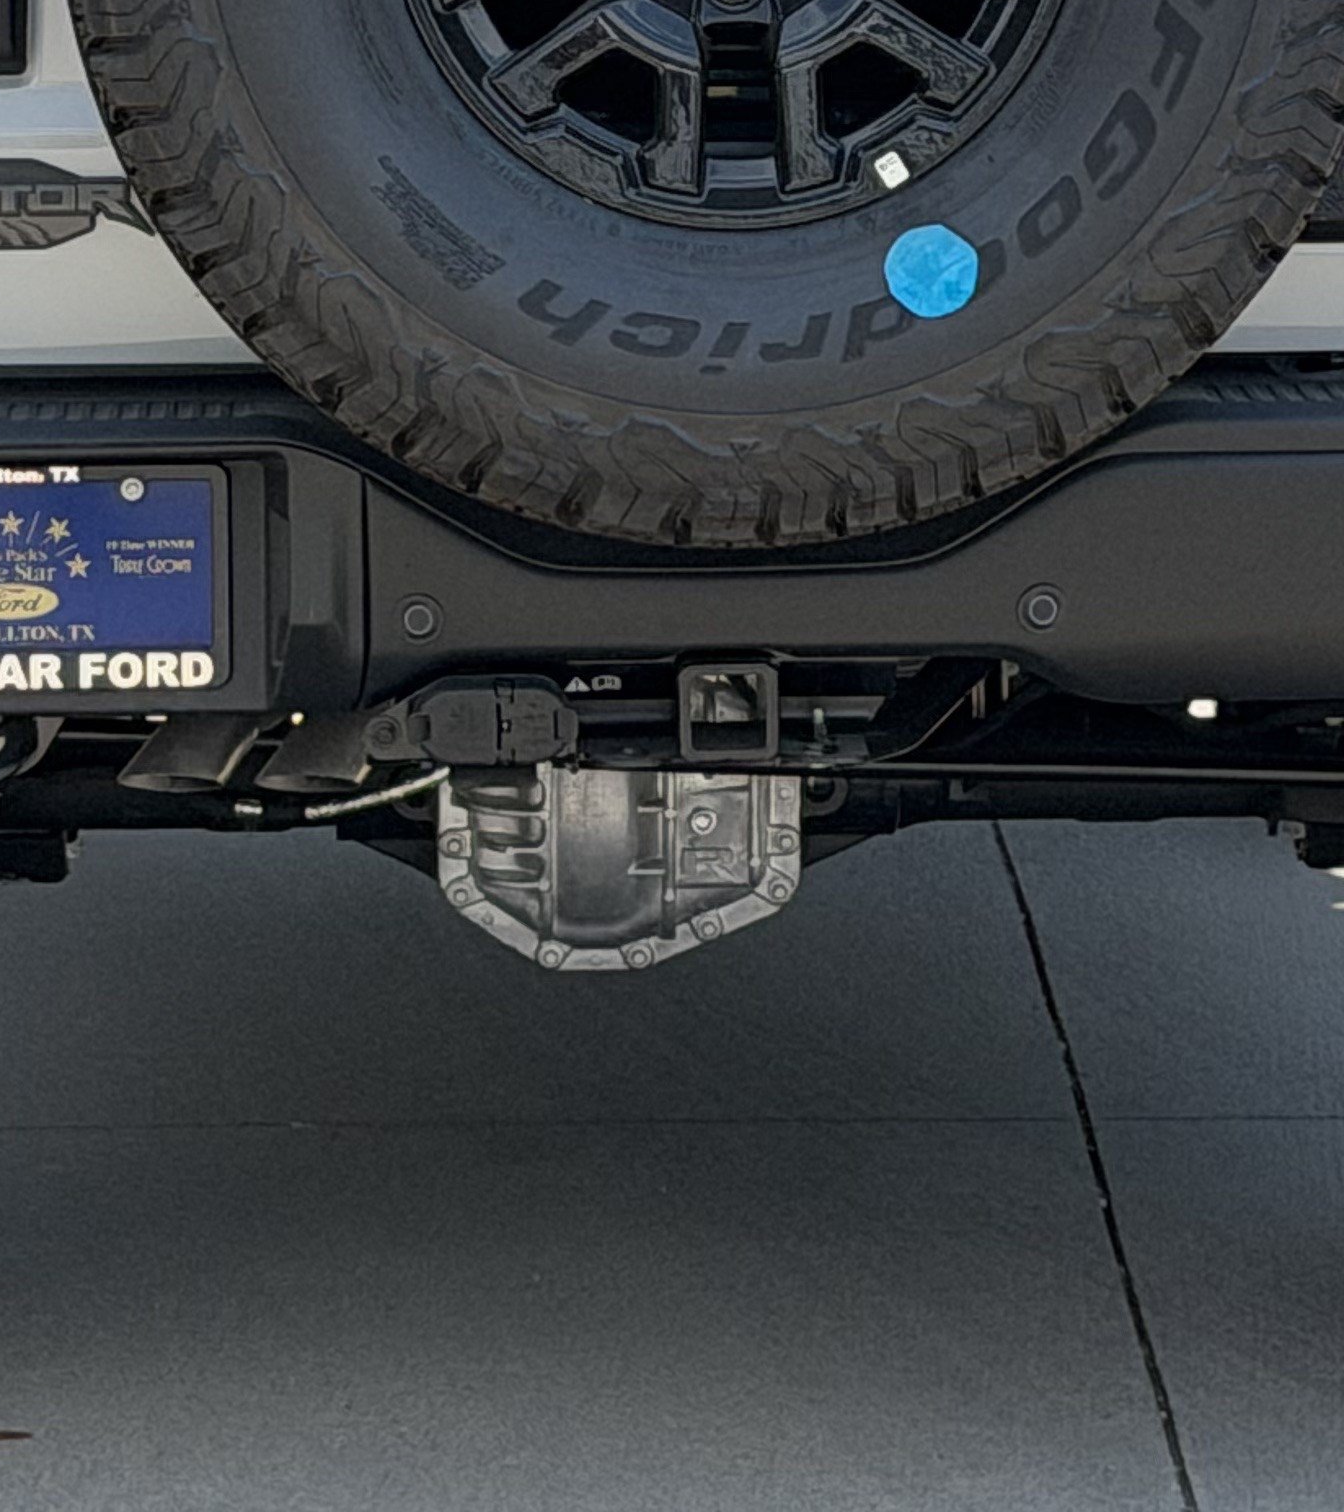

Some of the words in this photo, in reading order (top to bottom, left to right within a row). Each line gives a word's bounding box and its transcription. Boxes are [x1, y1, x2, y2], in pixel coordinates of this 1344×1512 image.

[49, 466, 80, 484] TX
[14, 562, 57, 582] Star
[67, 623, 96, 643] TX
[79, 652, 214, 689] FORD
